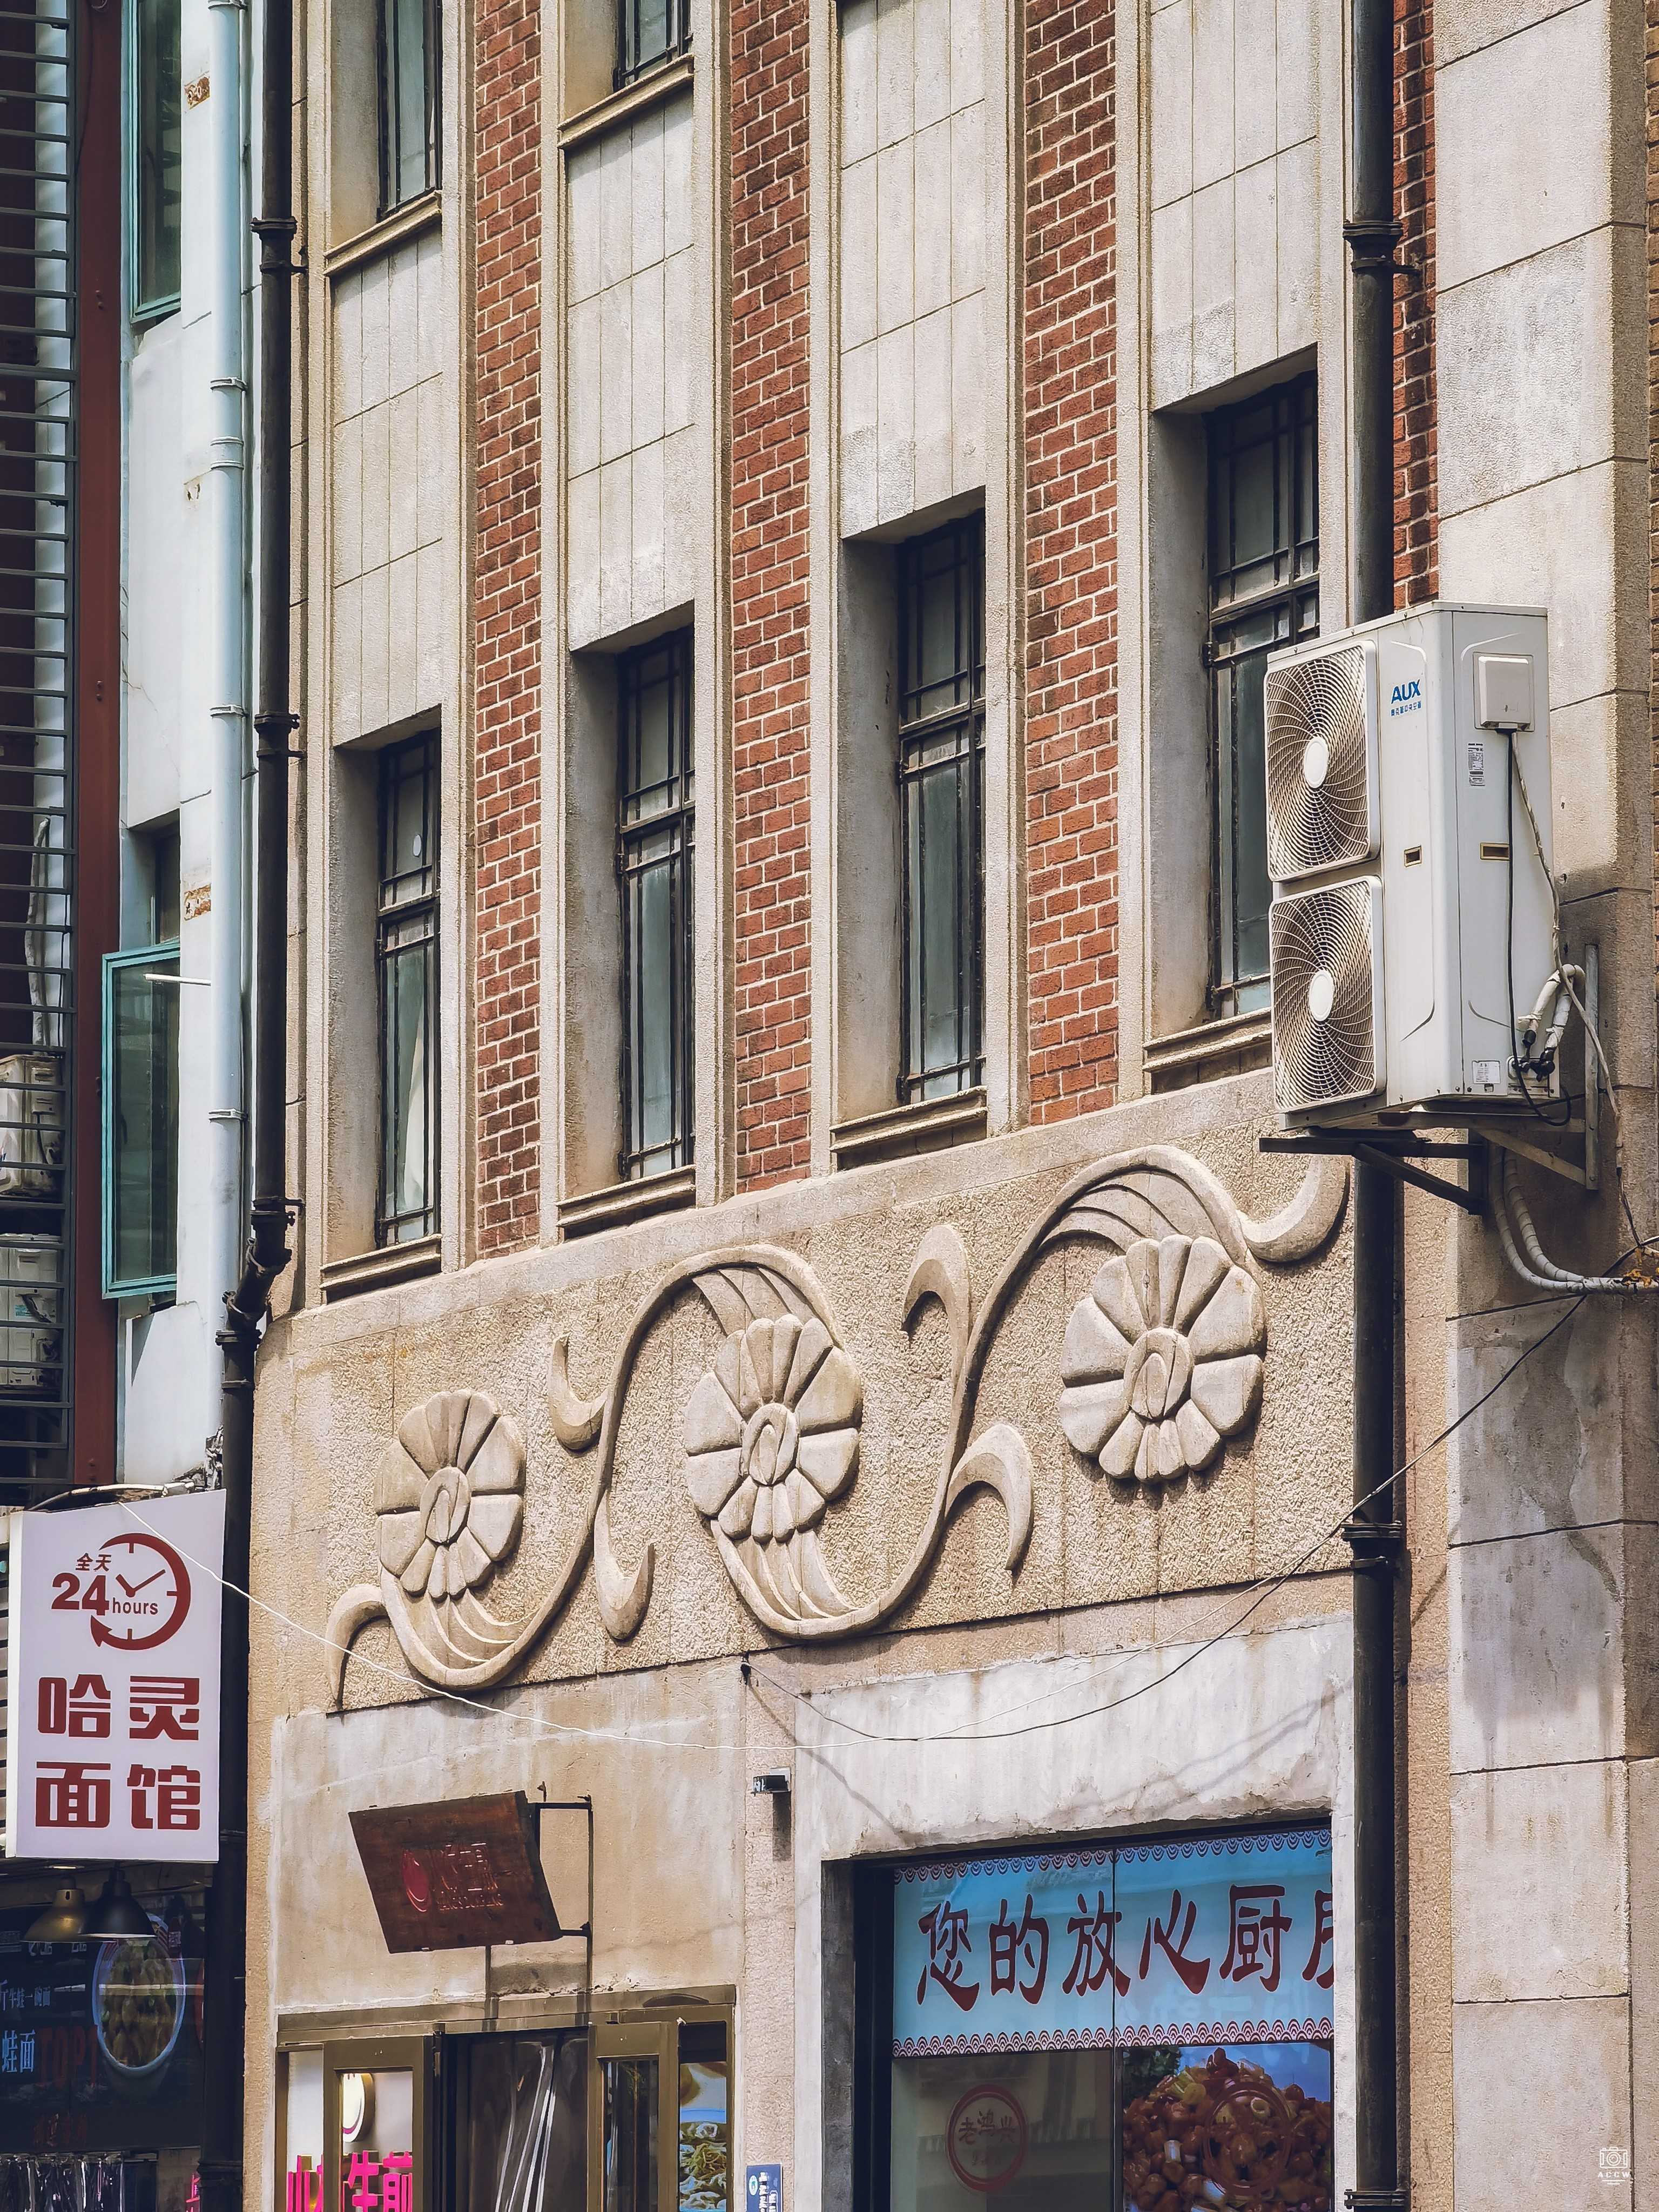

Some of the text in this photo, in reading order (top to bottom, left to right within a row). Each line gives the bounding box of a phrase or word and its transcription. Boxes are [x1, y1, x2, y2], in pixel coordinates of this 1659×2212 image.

[1391, 679, 1421, 704] AUX
[75, 1553, 112, 1572] 全天
[51, 1572, 158, 1616] 24 hours
[37, 1674, 200, 1740] 哈灵
[35, 1761, 200, 1830] 面馆
